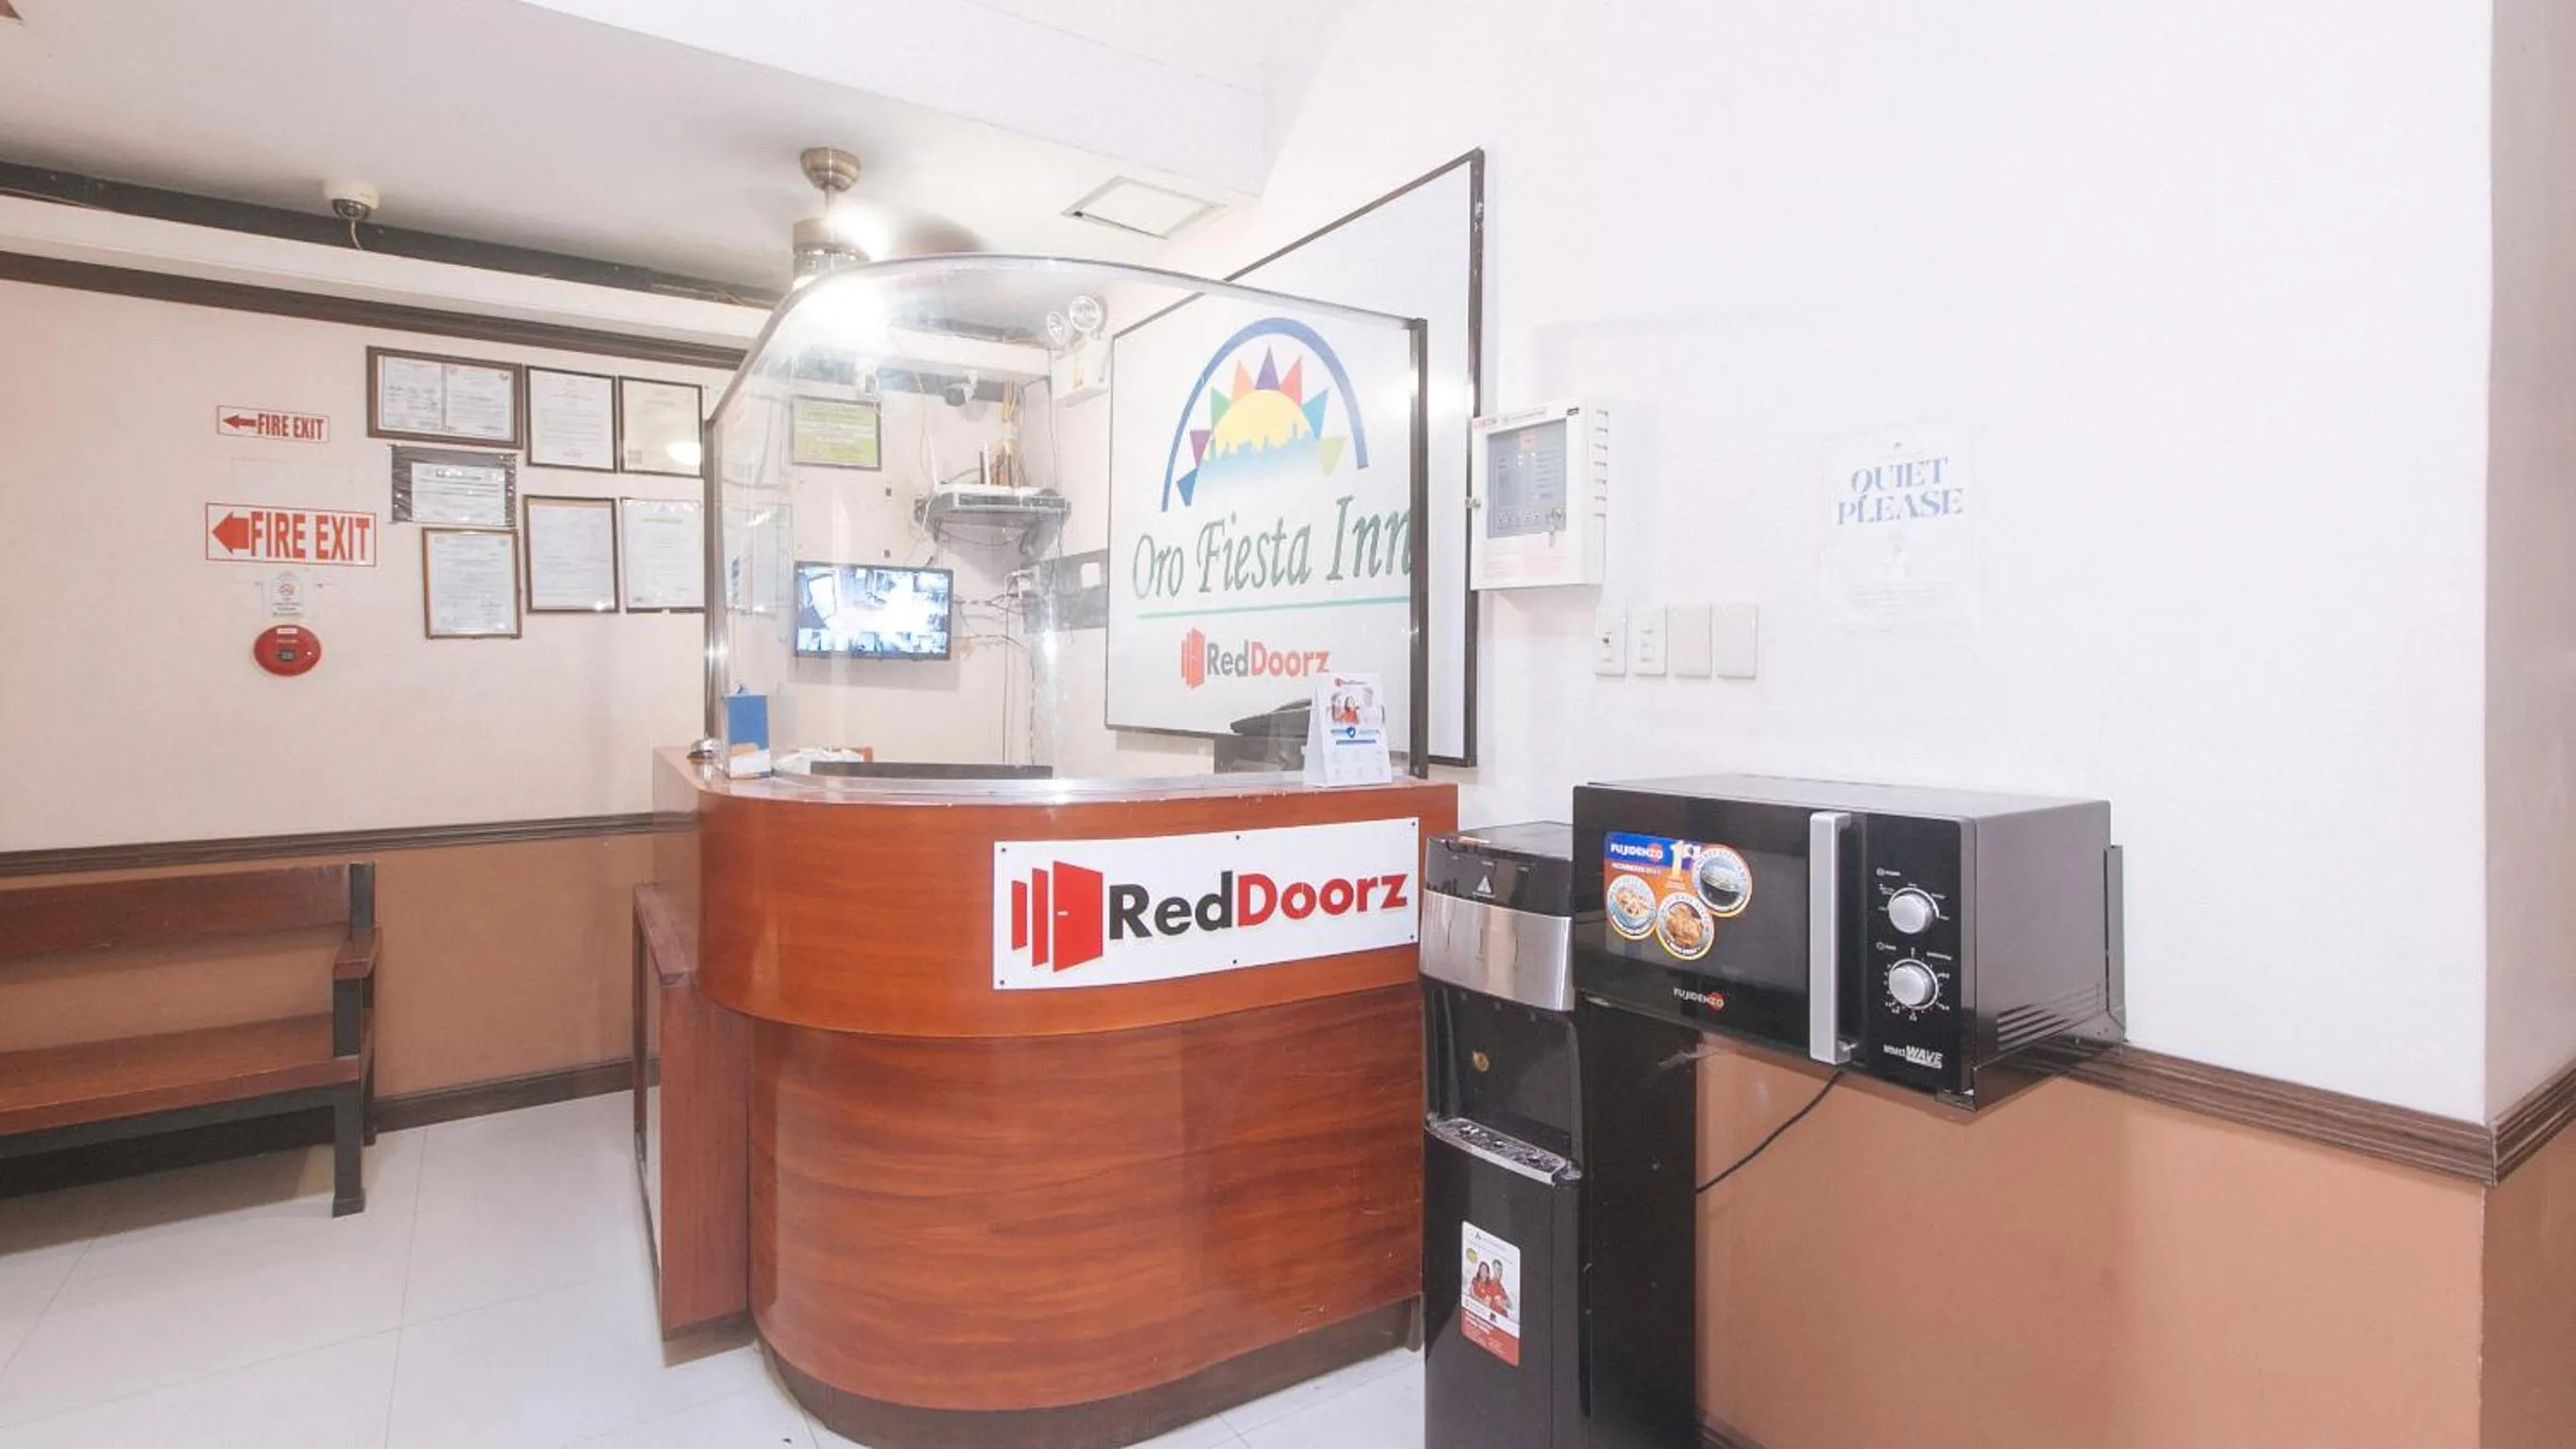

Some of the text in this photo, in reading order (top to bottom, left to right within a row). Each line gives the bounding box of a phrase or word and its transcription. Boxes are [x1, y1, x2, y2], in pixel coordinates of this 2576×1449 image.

[257, 413, 324, 440] FIRE EXIT
[1850, 457, 1948, 498] QUIET
[1837, 488, 1963, 525] PLEASE
[250, 510, 370, 562] FIRE EXIT
[1133, 494, 1411, 599] Oro Fiesta Inn
[1207, 639, 1330, 677] RedDoorz
[1610, 843, 1664, 861] FUJIDENZO
[1108, 869, 1408, 941] RedDoorz
[1672, 988, 1725, 1009] FUJIDENZO
